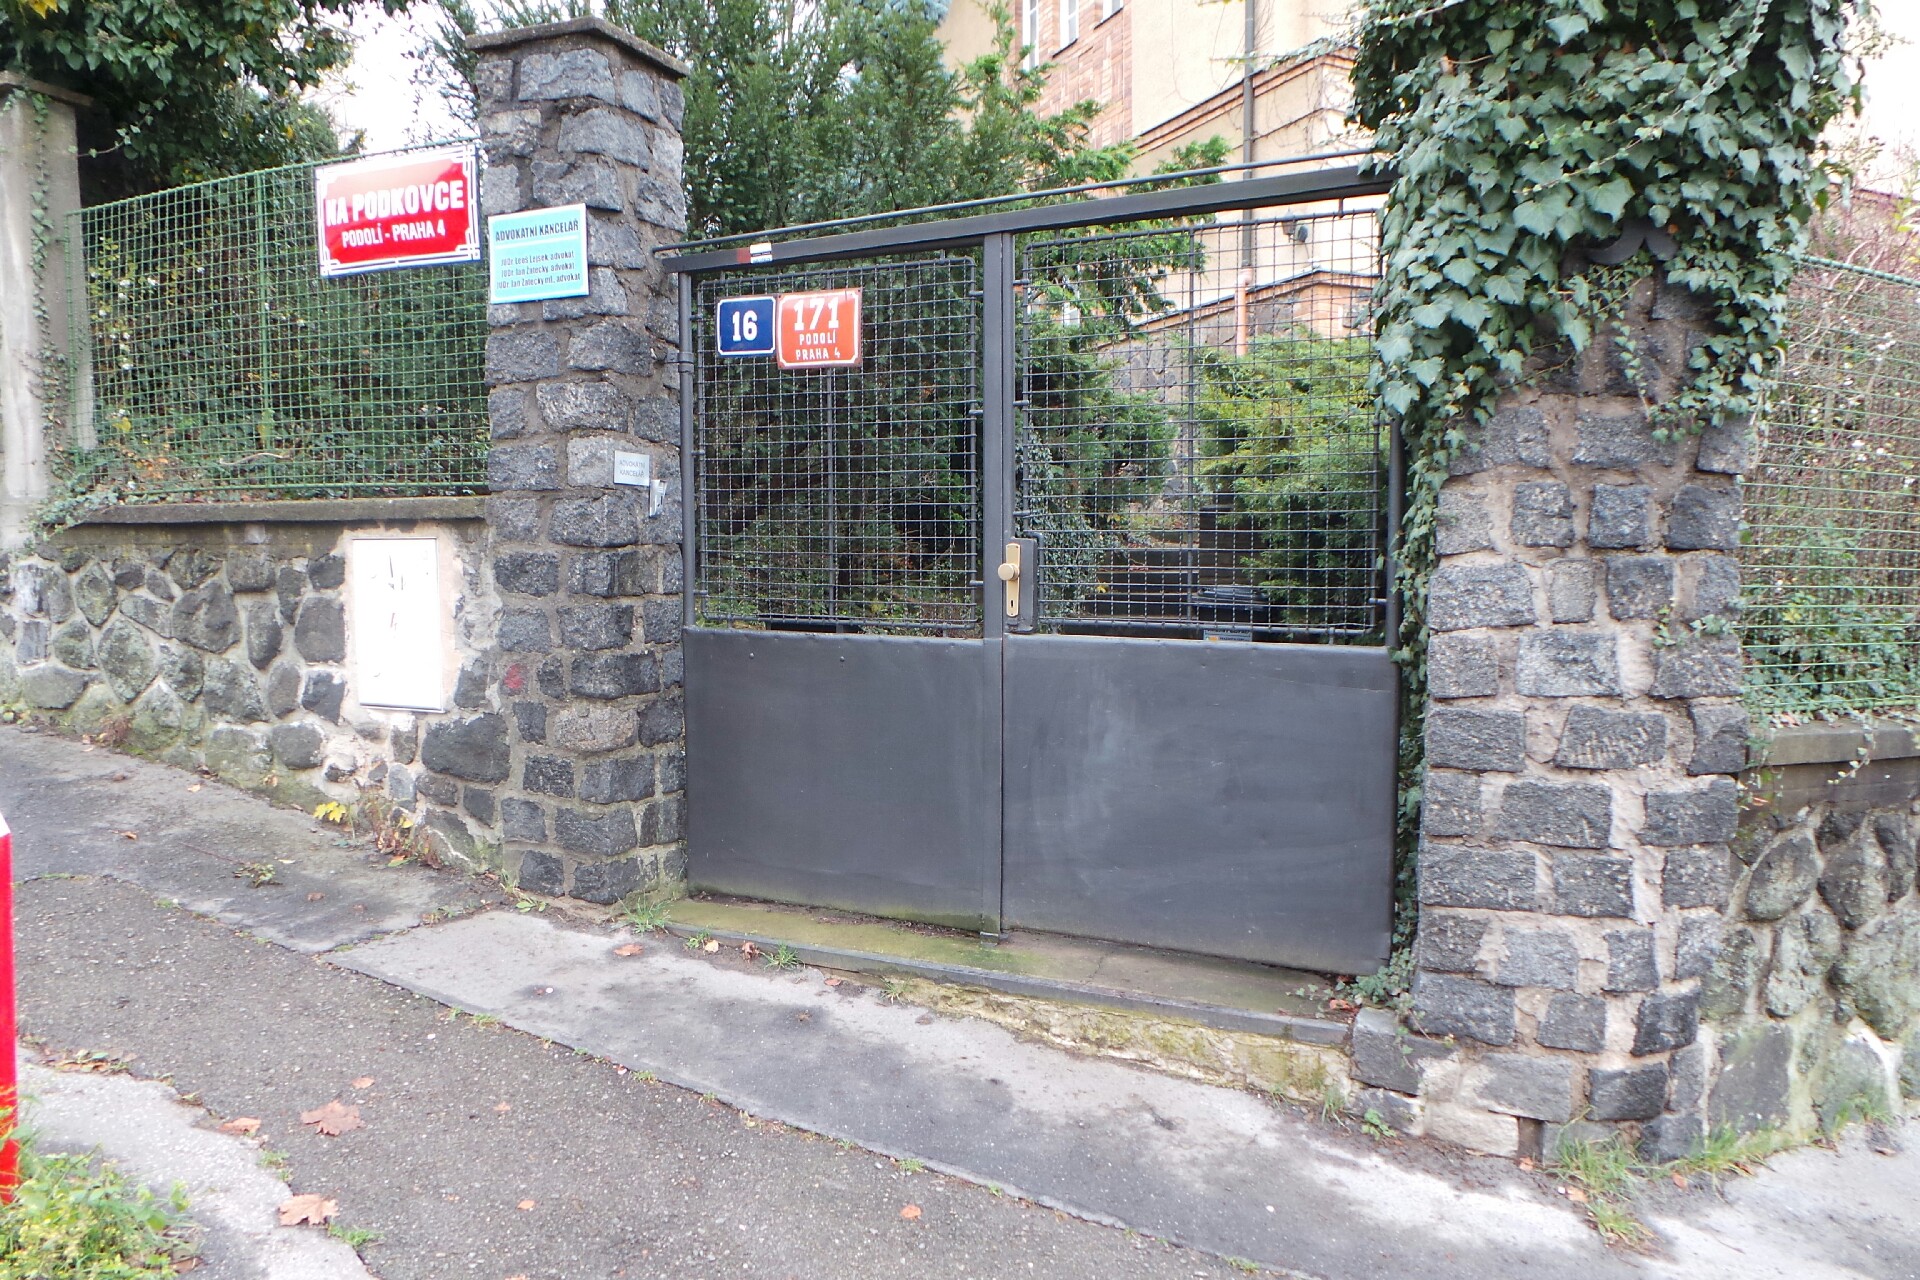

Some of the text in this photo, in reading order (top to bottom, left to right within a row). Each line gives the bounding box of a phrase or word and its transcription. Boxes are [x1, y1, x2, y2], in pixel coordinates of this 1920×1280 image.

[325, 180, 464, 227] NA PODKOVCE
[341, 222, 384, 248] PODOLÍ
[391, 220, 436, 242] PRAHA
[437, 219, 446, 236] 4
[732, 310, 758, 342] 16
[793, 296, 840, 331] 171
[799, 329, 836, 346] PODOLÍ
[795, 346, 841, 360] PRAHA 4
